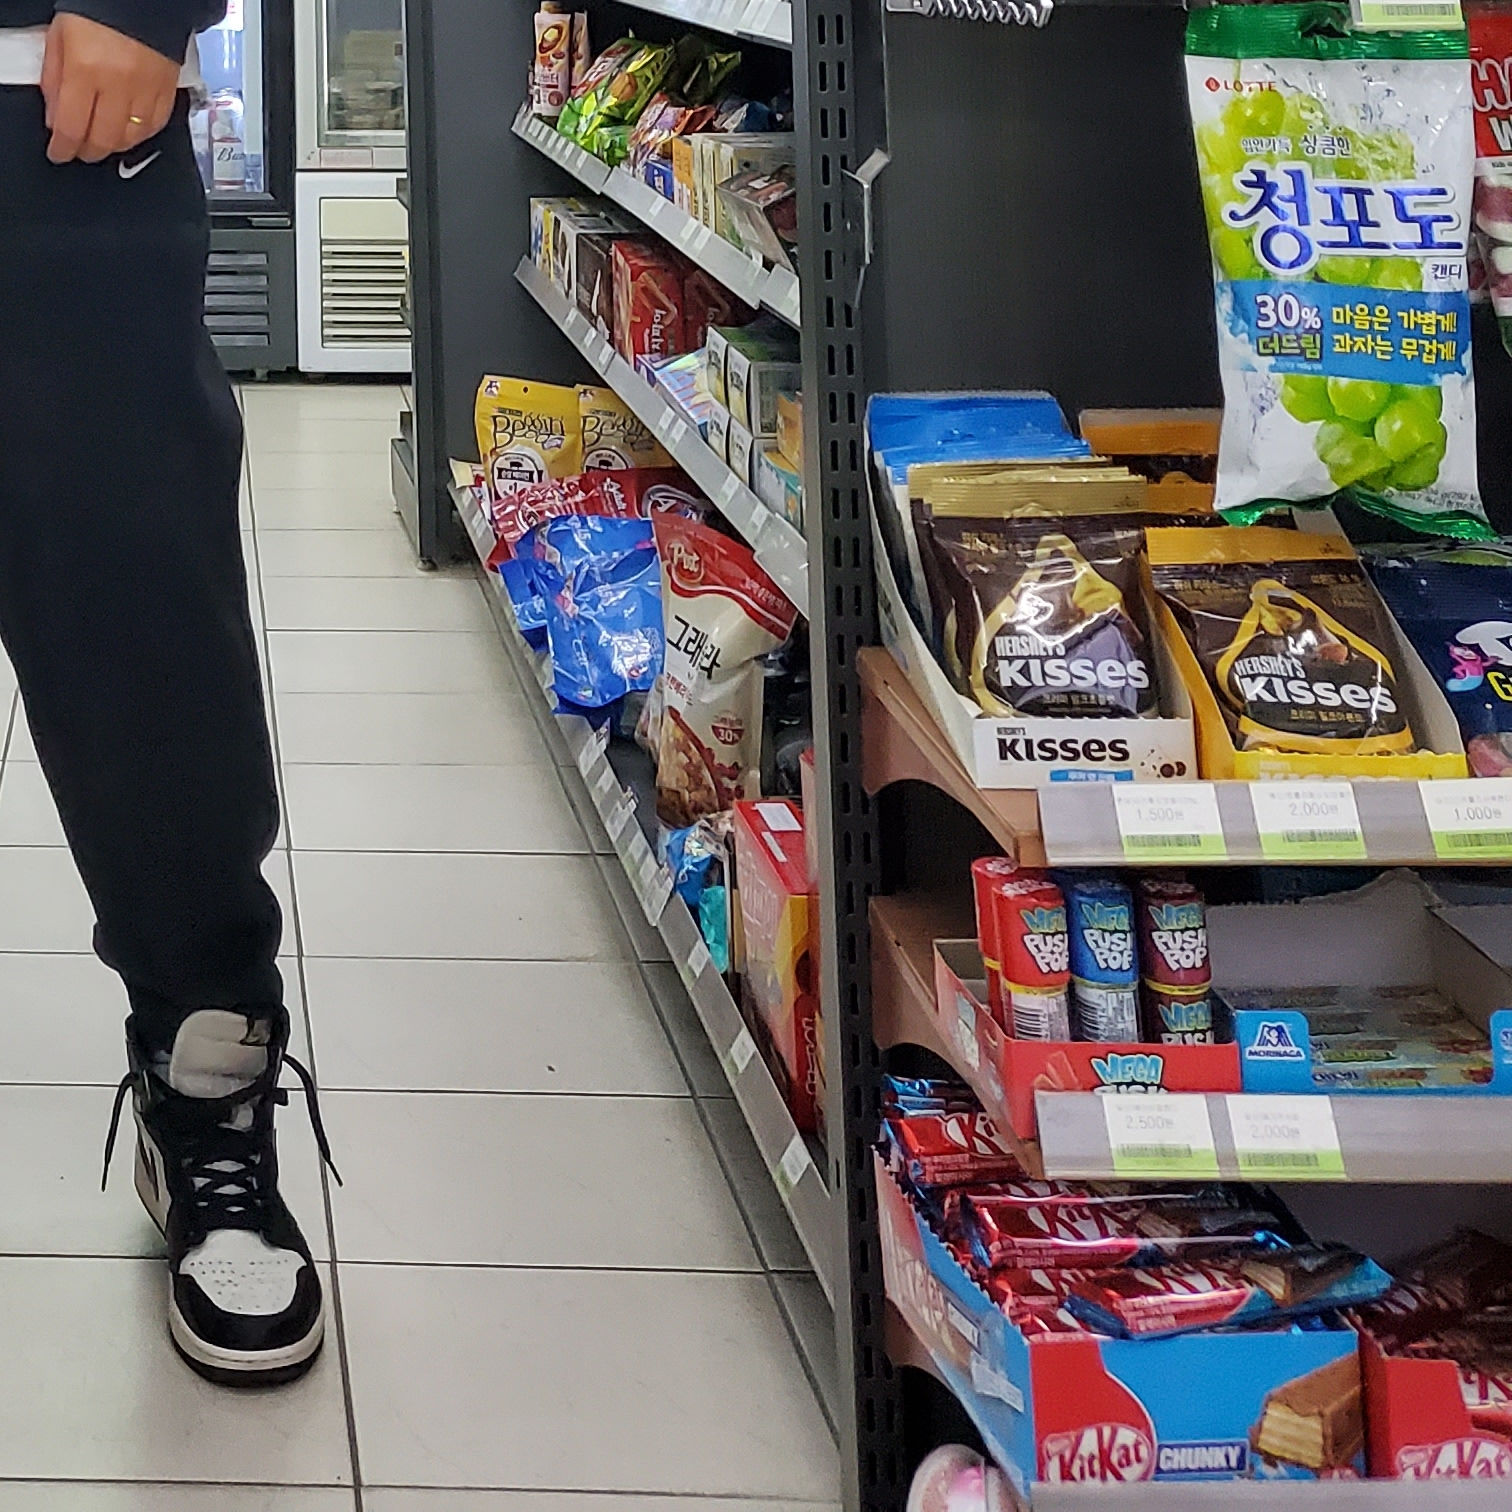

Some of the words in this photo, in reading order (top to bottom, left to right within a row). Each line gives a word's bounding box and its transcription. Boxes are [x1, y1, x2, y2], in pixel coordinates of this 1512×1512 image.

[1224, 80, 1278, 93] LOTTE
[1301, 134, 1350, 156] 상큼한
[1229, 168, 1465, 271] 청포도
[1432, 260, 1464, 281] 캔디
[1255, 294, 1320, 330] 30%
[1332, 305, 1392, 332] 마음은
[1398, 305, 1458, 335] 가볍게!
[1257, 332, 1321, 360] 더드림
[1332, 334, 1393, 360] 과자는
[1399, 336, 1458, 363] 무겁게!
[1152, 929, 1207, 952] PUSH
[1163, 948, 1208, 972] POP
[1090, 1054, 1164, 1084] MEGA
[1159, 1445, 1241, 1472] CHUNKY
